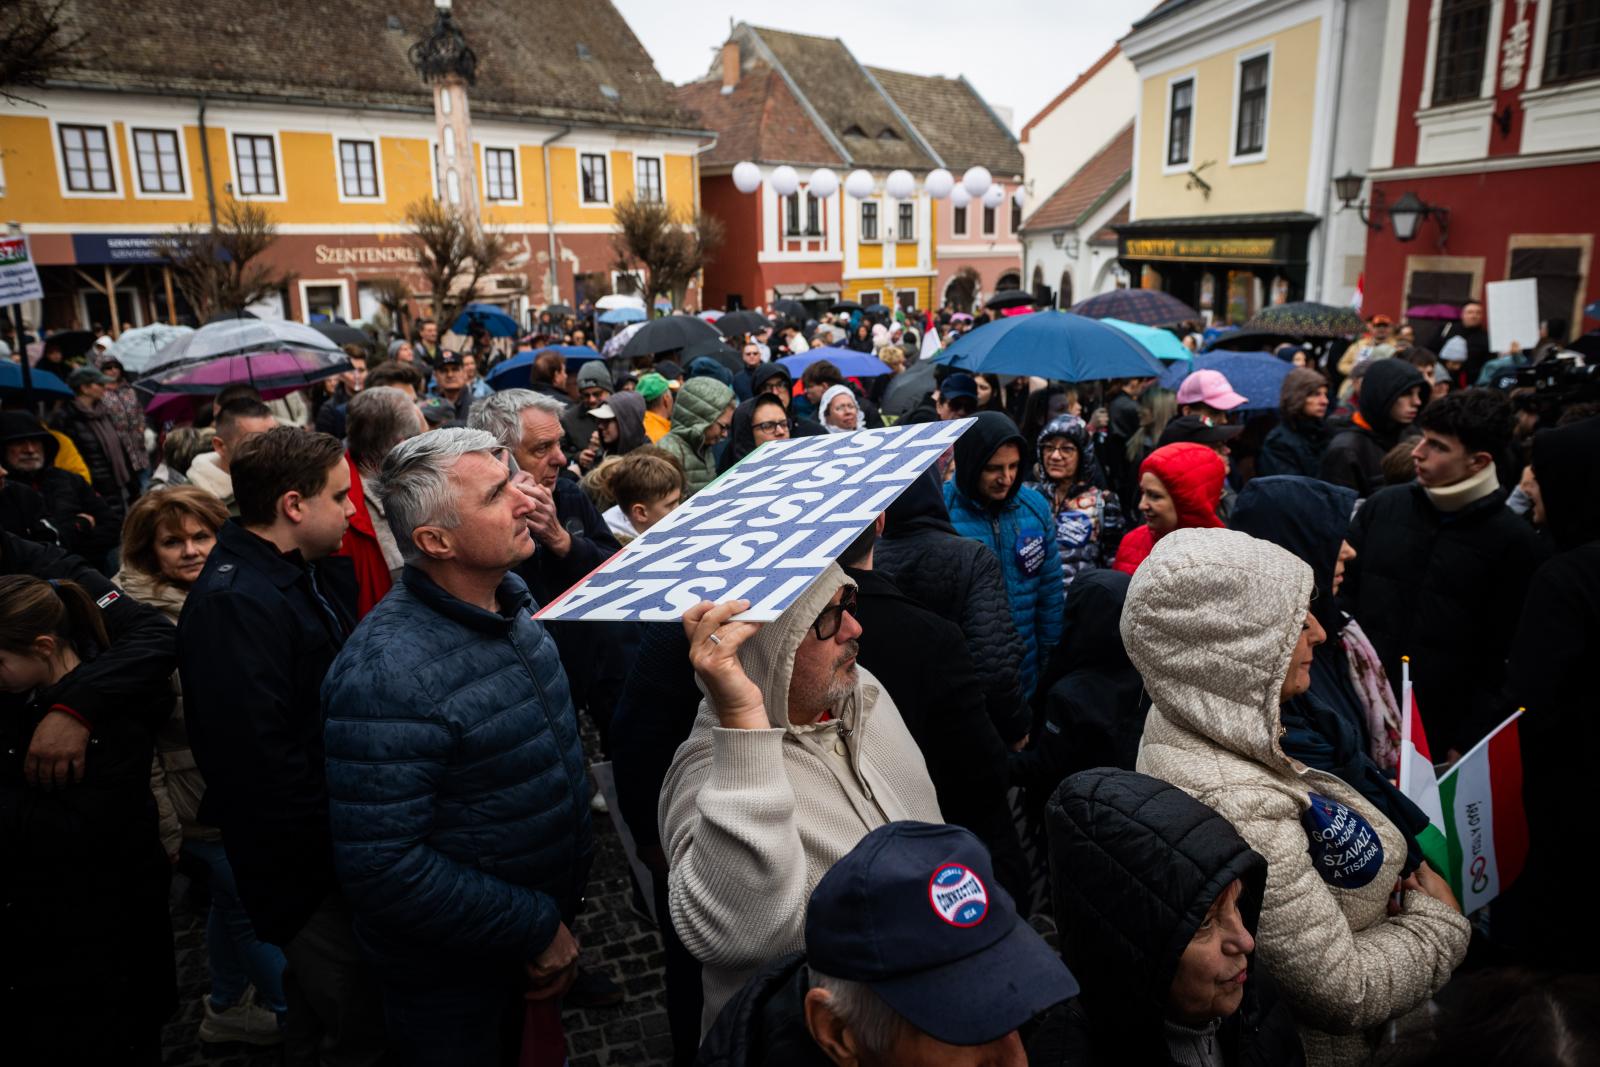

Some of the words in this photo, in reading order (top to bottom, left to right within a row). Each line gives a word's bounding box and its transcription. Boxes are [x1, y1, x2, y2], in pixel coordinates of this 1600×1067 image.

[742, 417, 978, 464] TISZA
[698, 449, 942, 497] TISZA
[650, 485, 904, 532] TISZA
[596, 527, 863, 575] TISZA
[1323, 826, 1372, 866] SZAVAZZ
[1334, 870, 1343, 878] A
[1344, 843, 1379, 875] TISZÁRA!
